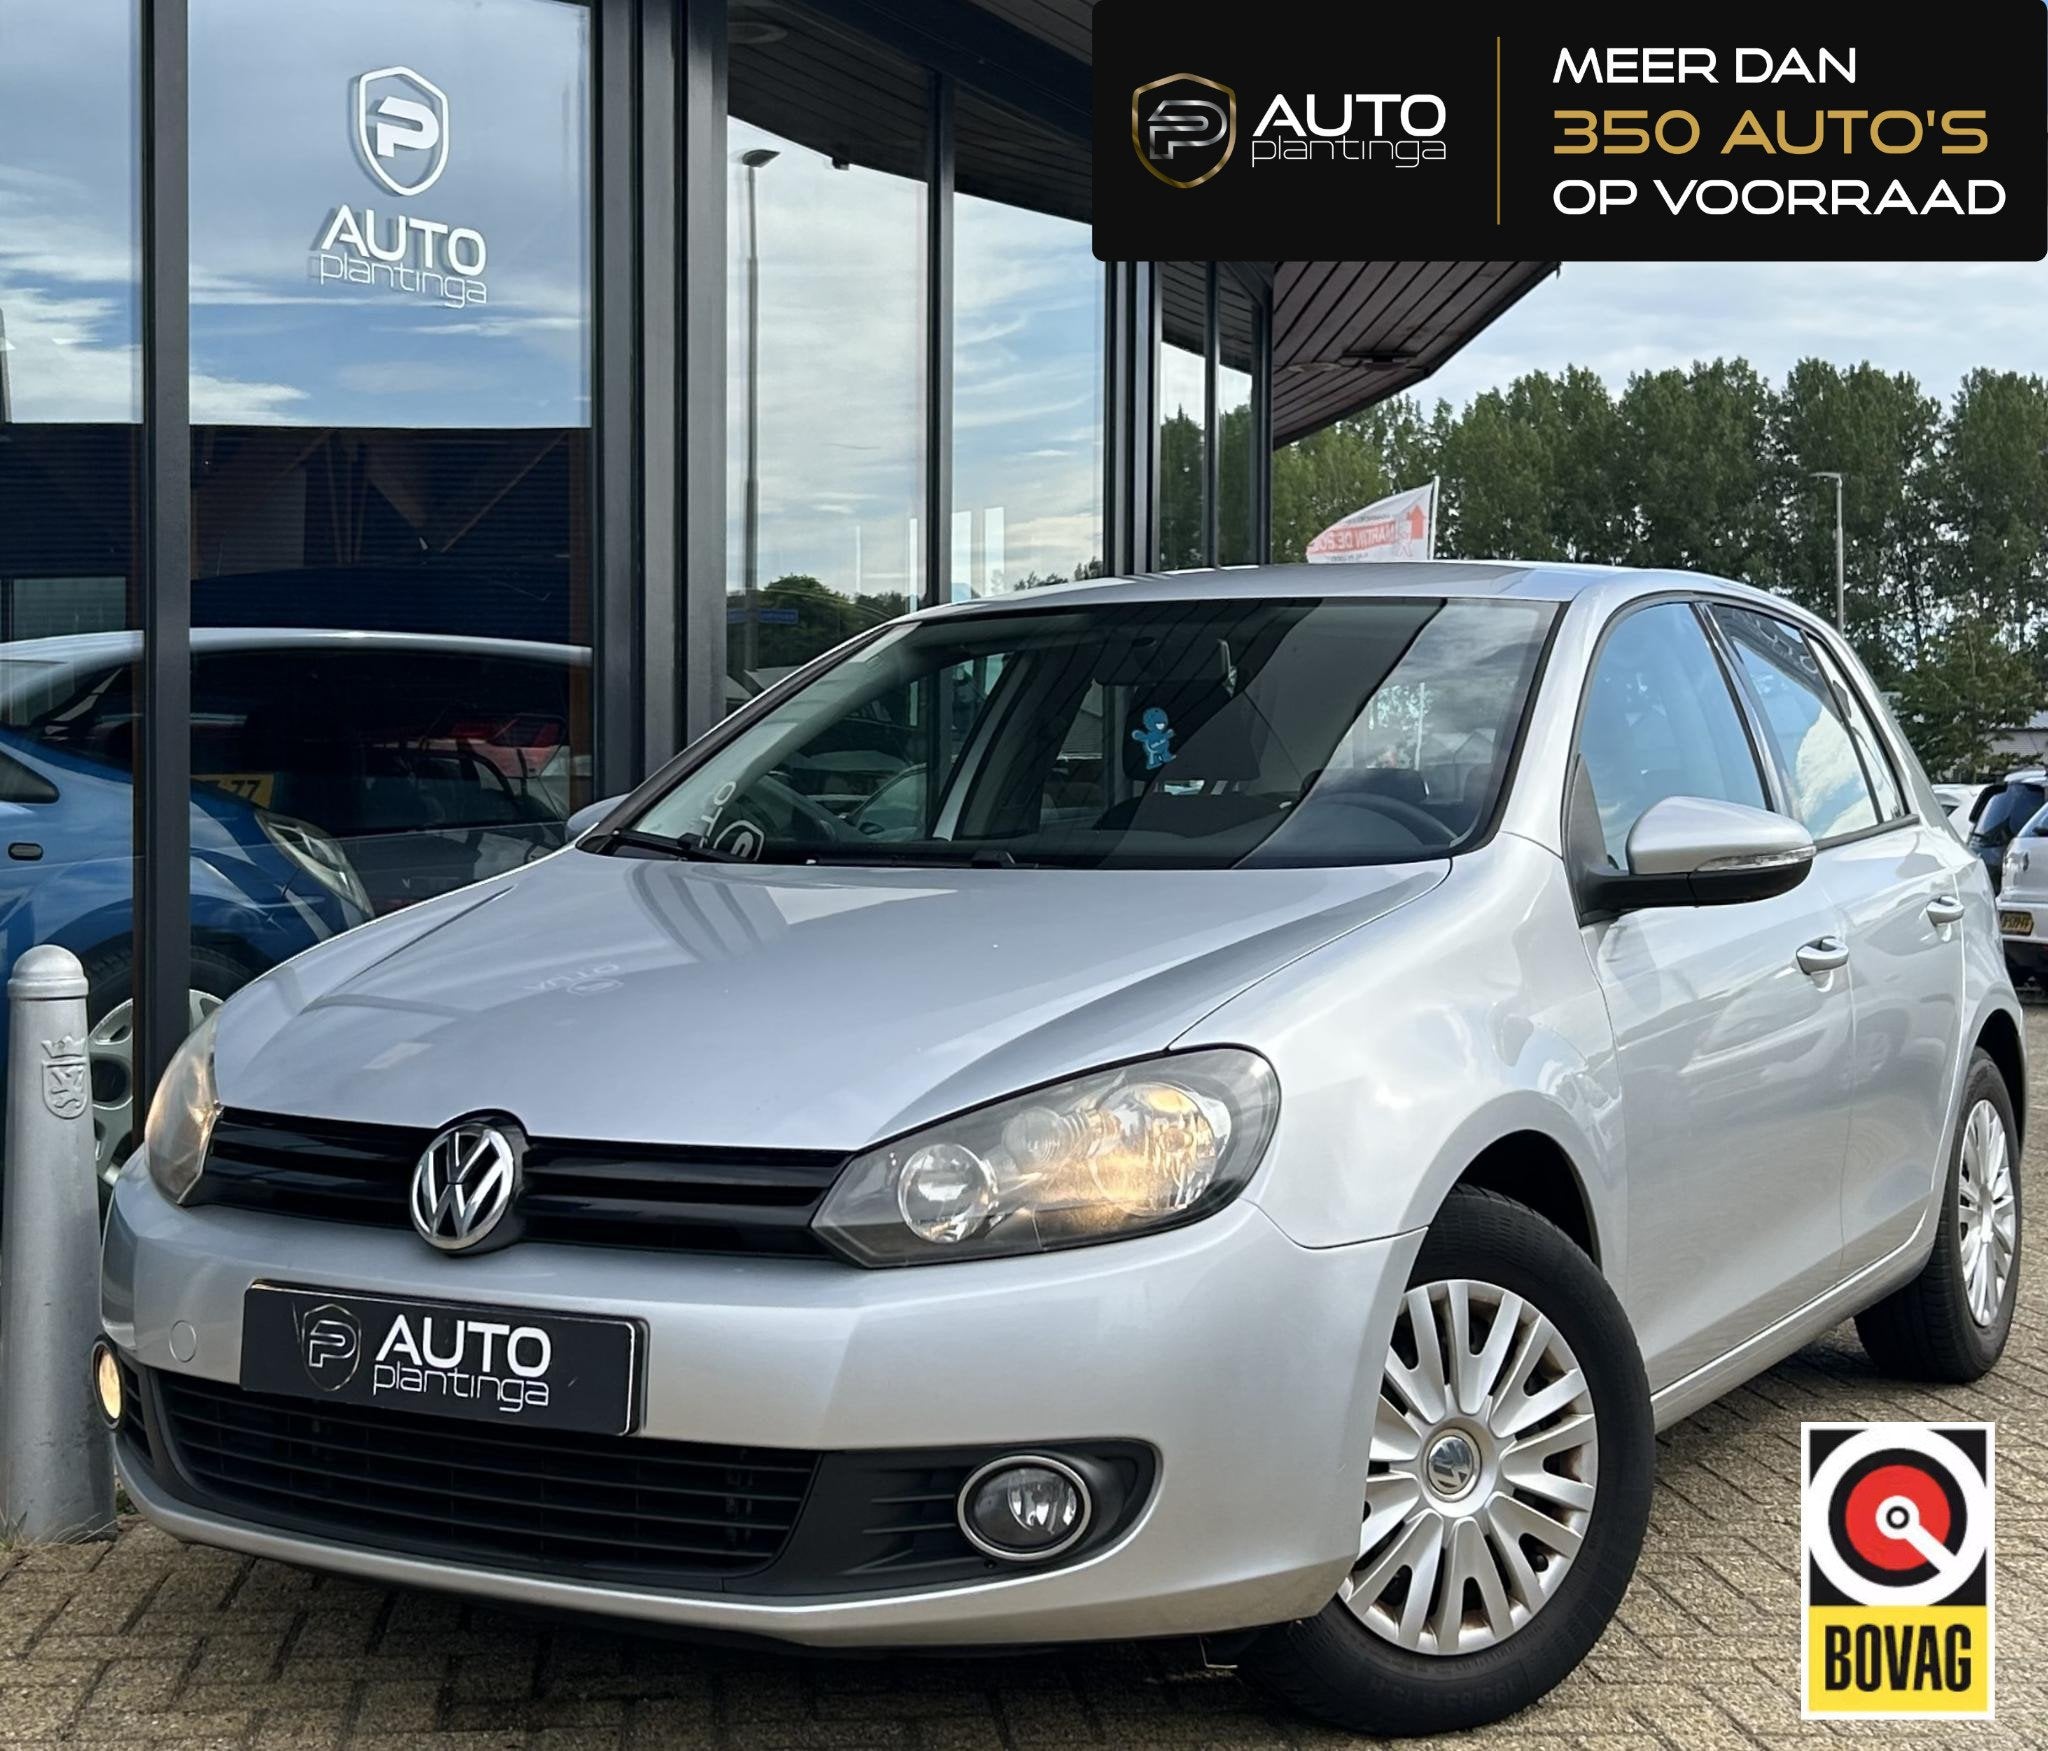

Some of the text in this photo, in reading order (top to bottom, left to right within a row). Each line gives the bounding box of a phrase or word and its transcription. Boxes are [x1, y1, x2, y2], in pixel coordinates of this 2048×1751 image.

[320, 204, 487, 277] AUTO
[319, 251, 487, 309] plantinga
[374, 1313, 552, 1378] AUTO
[372, 1360, 550, 1413] plantinga
